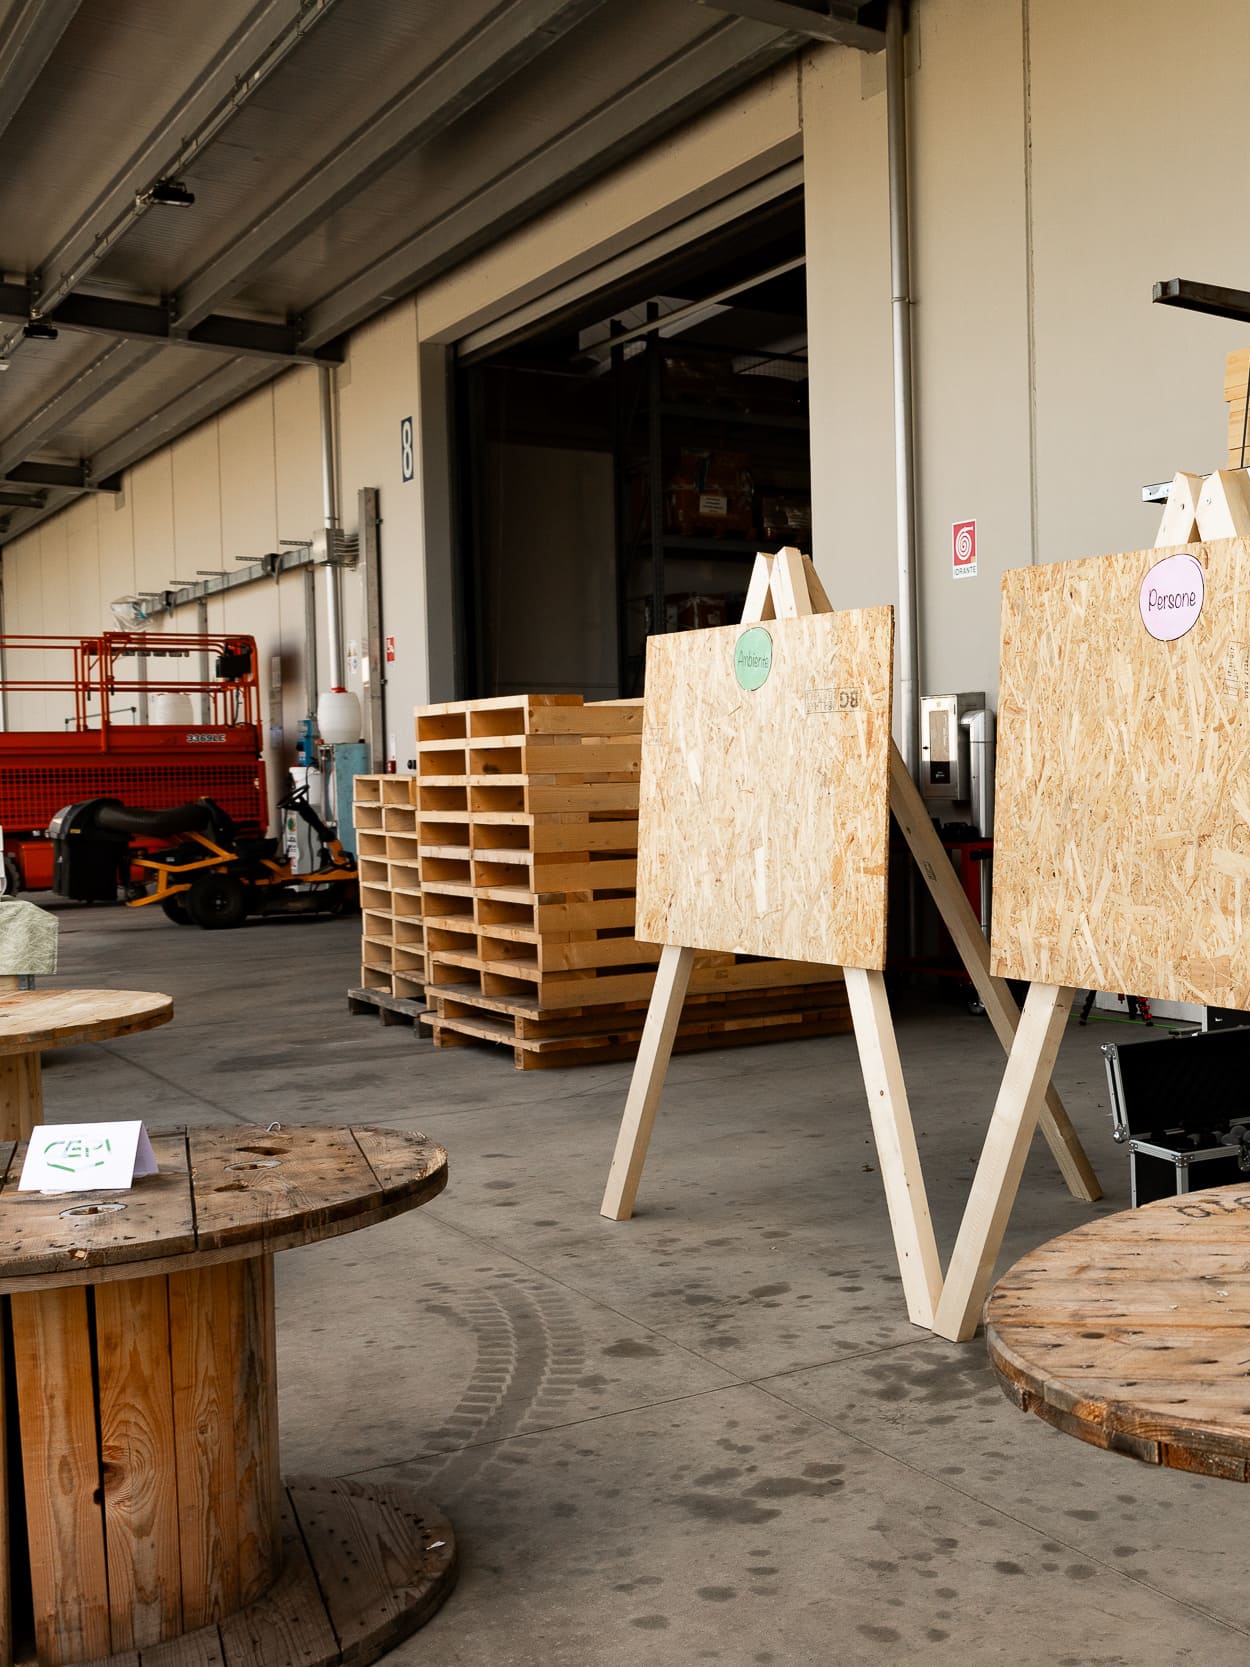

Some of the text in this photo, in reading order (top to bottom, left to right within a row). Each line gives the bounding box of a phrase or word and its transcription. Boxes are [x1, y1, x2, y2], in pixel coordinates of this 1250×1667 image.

[402, 420, 413, 478] 8
[953, 565, 977, 576] IDRANTE
[1147, 588, 1196, 612] Persone
[737, 650, 770, 669] Ambiente
[186, 733, 226, 743] 3369LE
